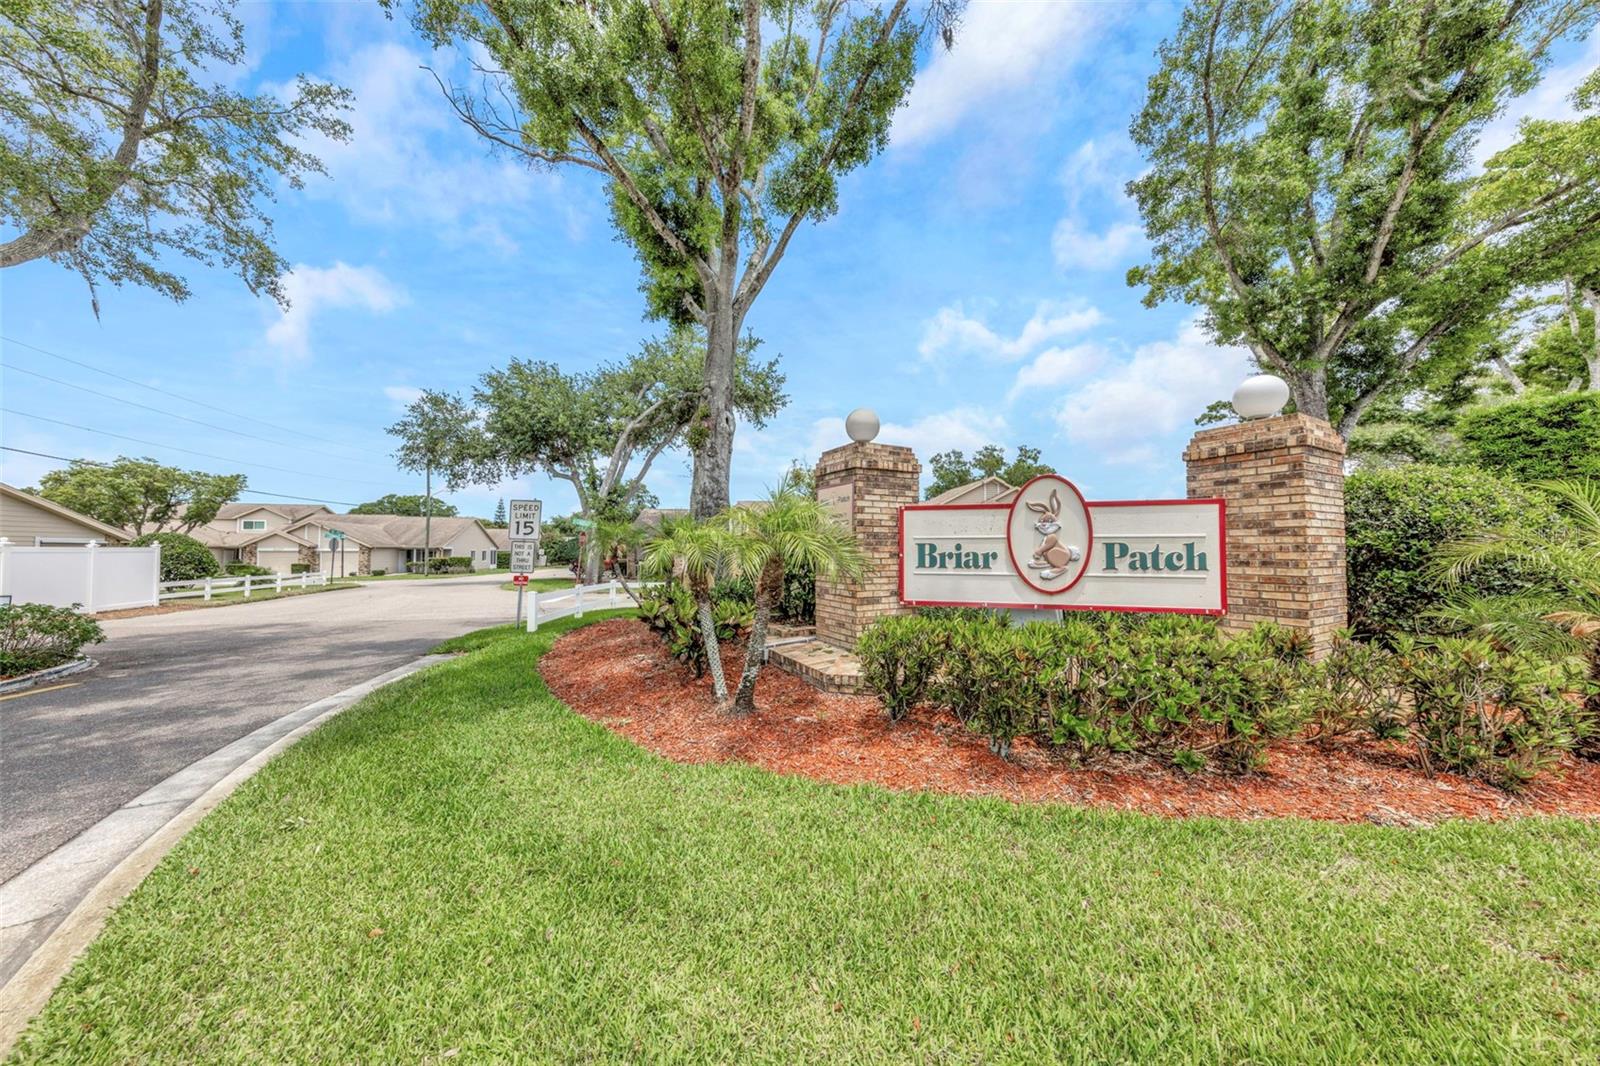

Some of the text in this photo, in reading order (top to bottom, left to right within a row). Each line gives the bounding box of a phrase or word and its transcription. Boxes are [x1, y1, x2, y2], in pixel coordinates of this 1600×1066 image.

[515, 521, 534, 535] 15
[915, 541, 1209, 571] Briar Patch
